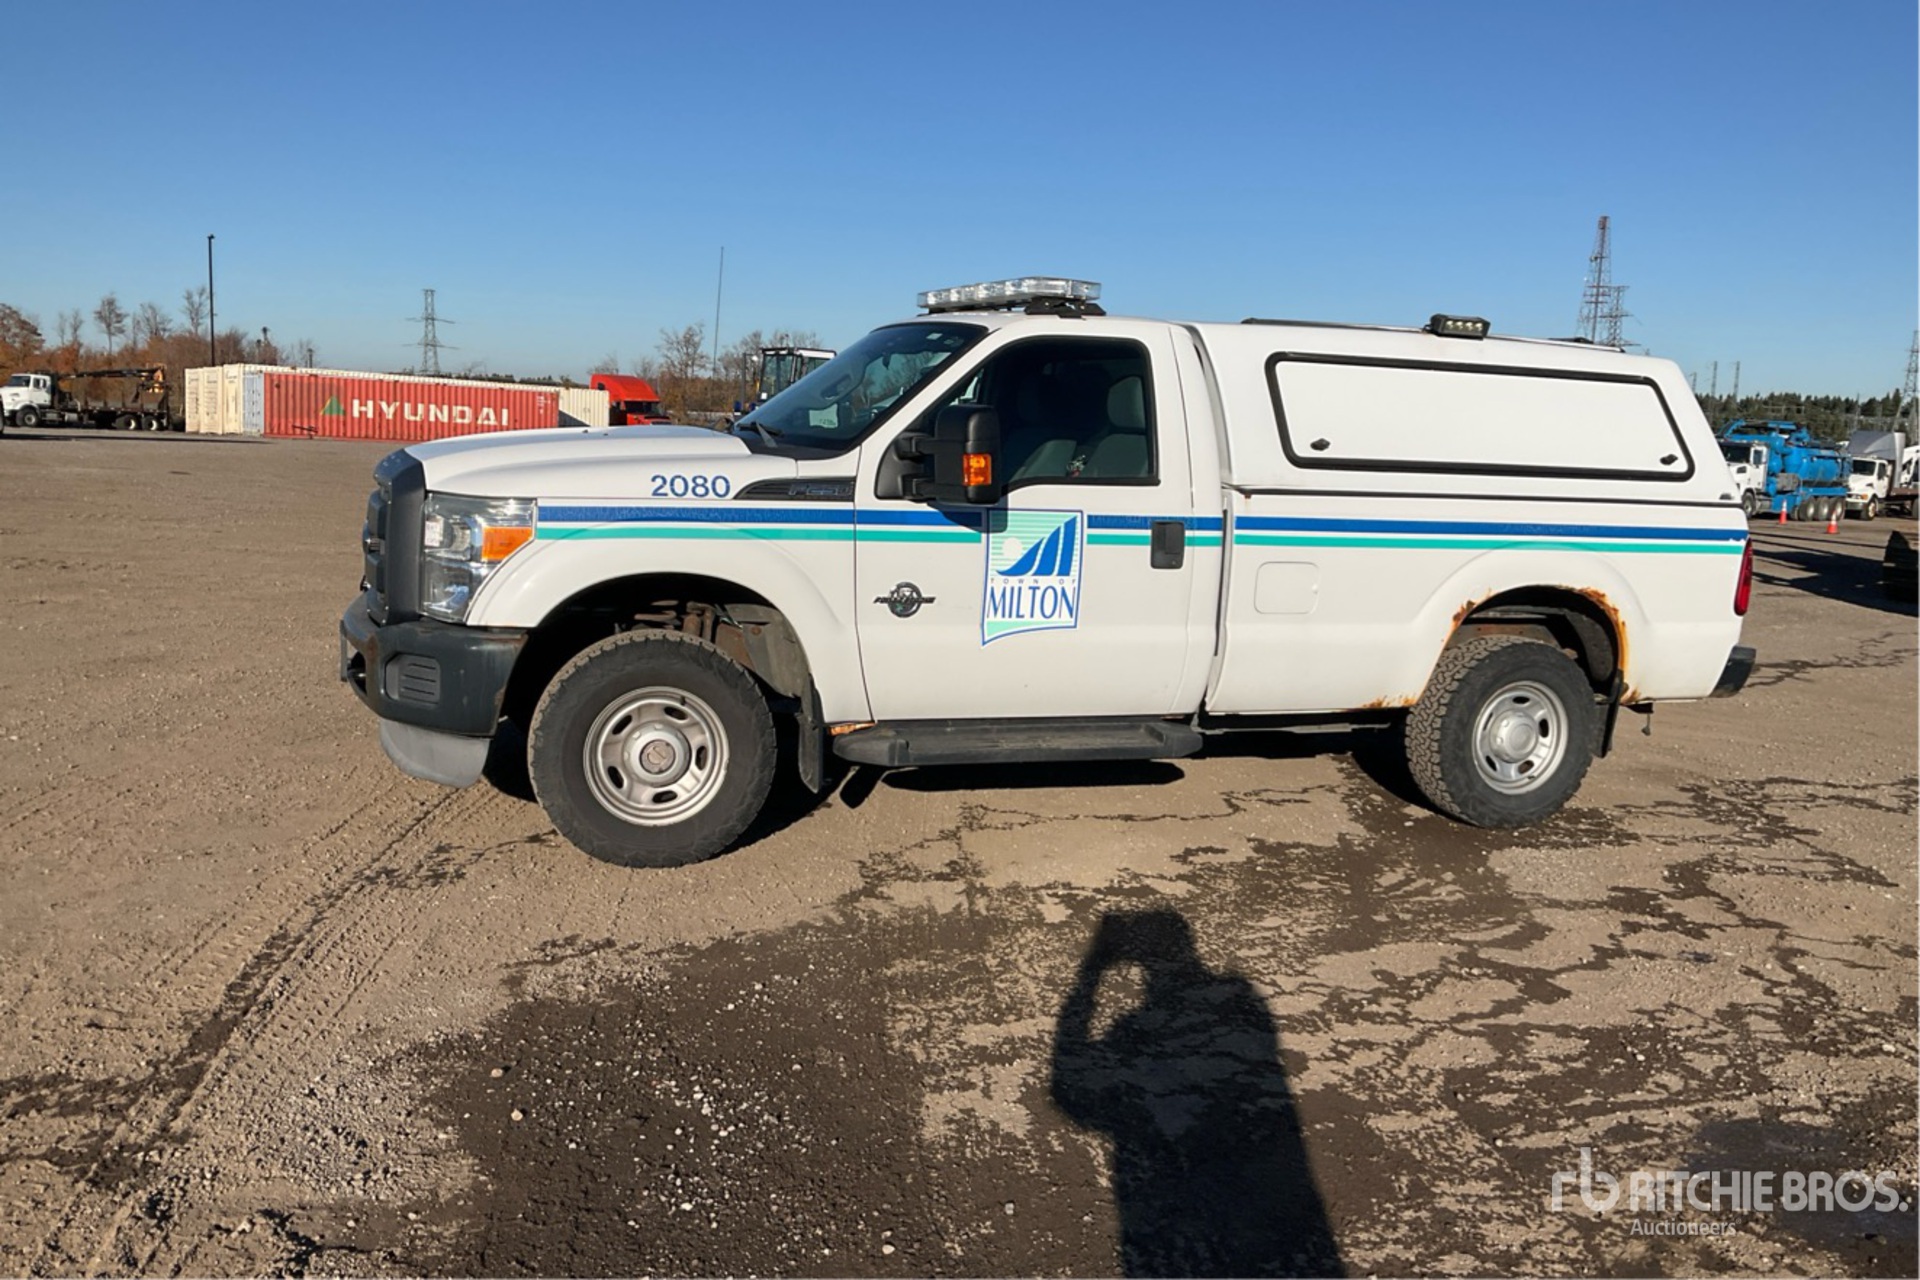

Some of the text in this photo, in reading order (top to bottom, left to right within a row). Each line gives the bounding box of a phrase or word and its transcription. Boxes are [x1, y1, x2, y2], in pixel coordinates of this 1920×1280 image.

[352, 398, 509, 426] HYUNDAI
[651, 474, 731, 498] 2080
[990, 577, 1077, 585] TOWN OF
[986, 585, 1077, 619] MILTON
